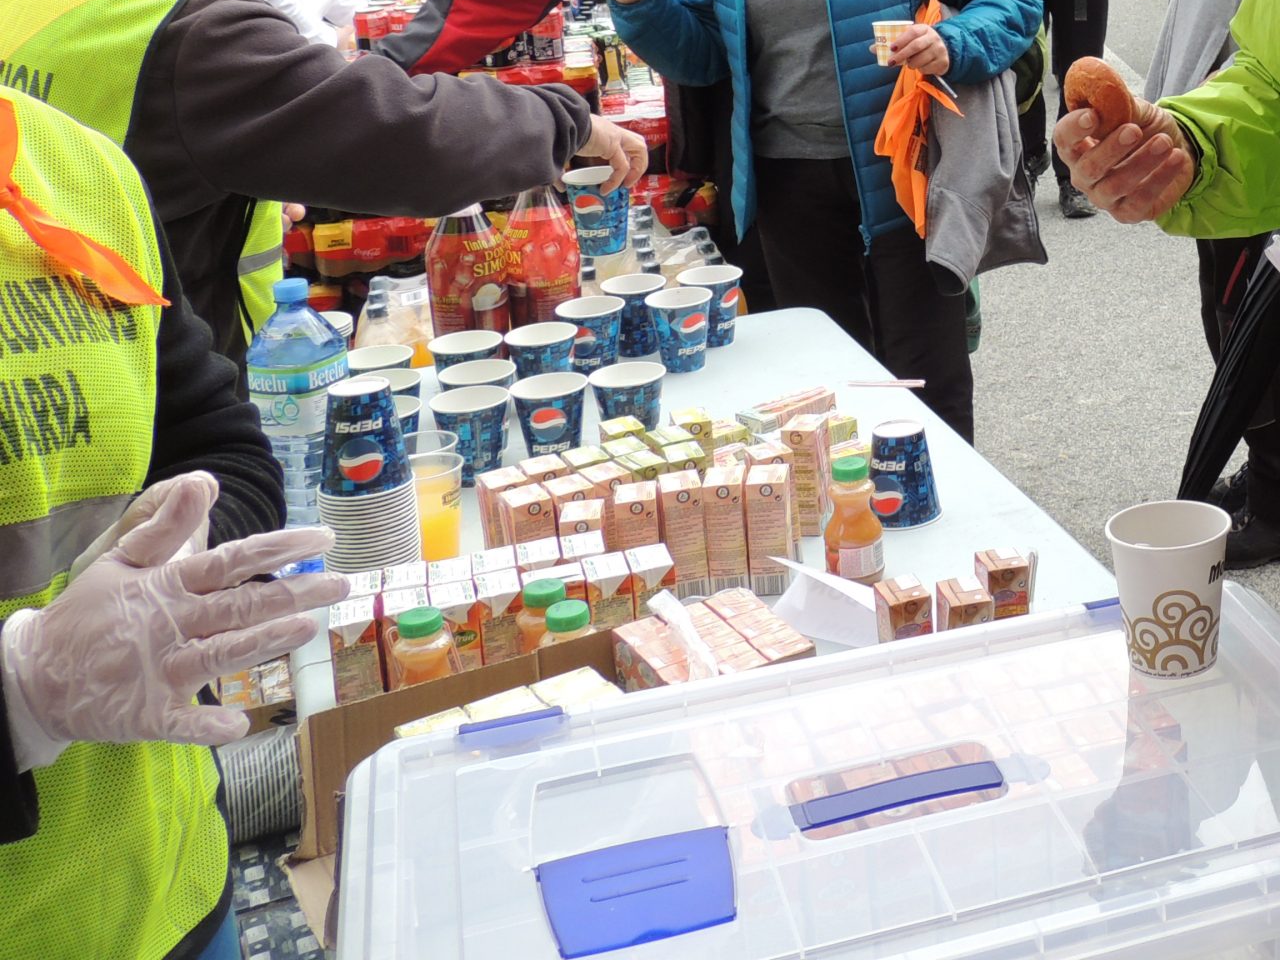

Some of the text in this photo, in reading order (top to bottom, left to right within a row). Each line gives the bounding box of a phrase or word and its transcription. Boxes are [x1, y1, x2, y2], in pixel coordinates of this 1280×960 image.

[505, 228, 529, 239] erano
[577, 228, 610, 238] PEPSI
[308, 361, 345, 390] Betelu
[335, 417, 383, 434] PEPSI
[532, 440, 571, 454] PEPSI
